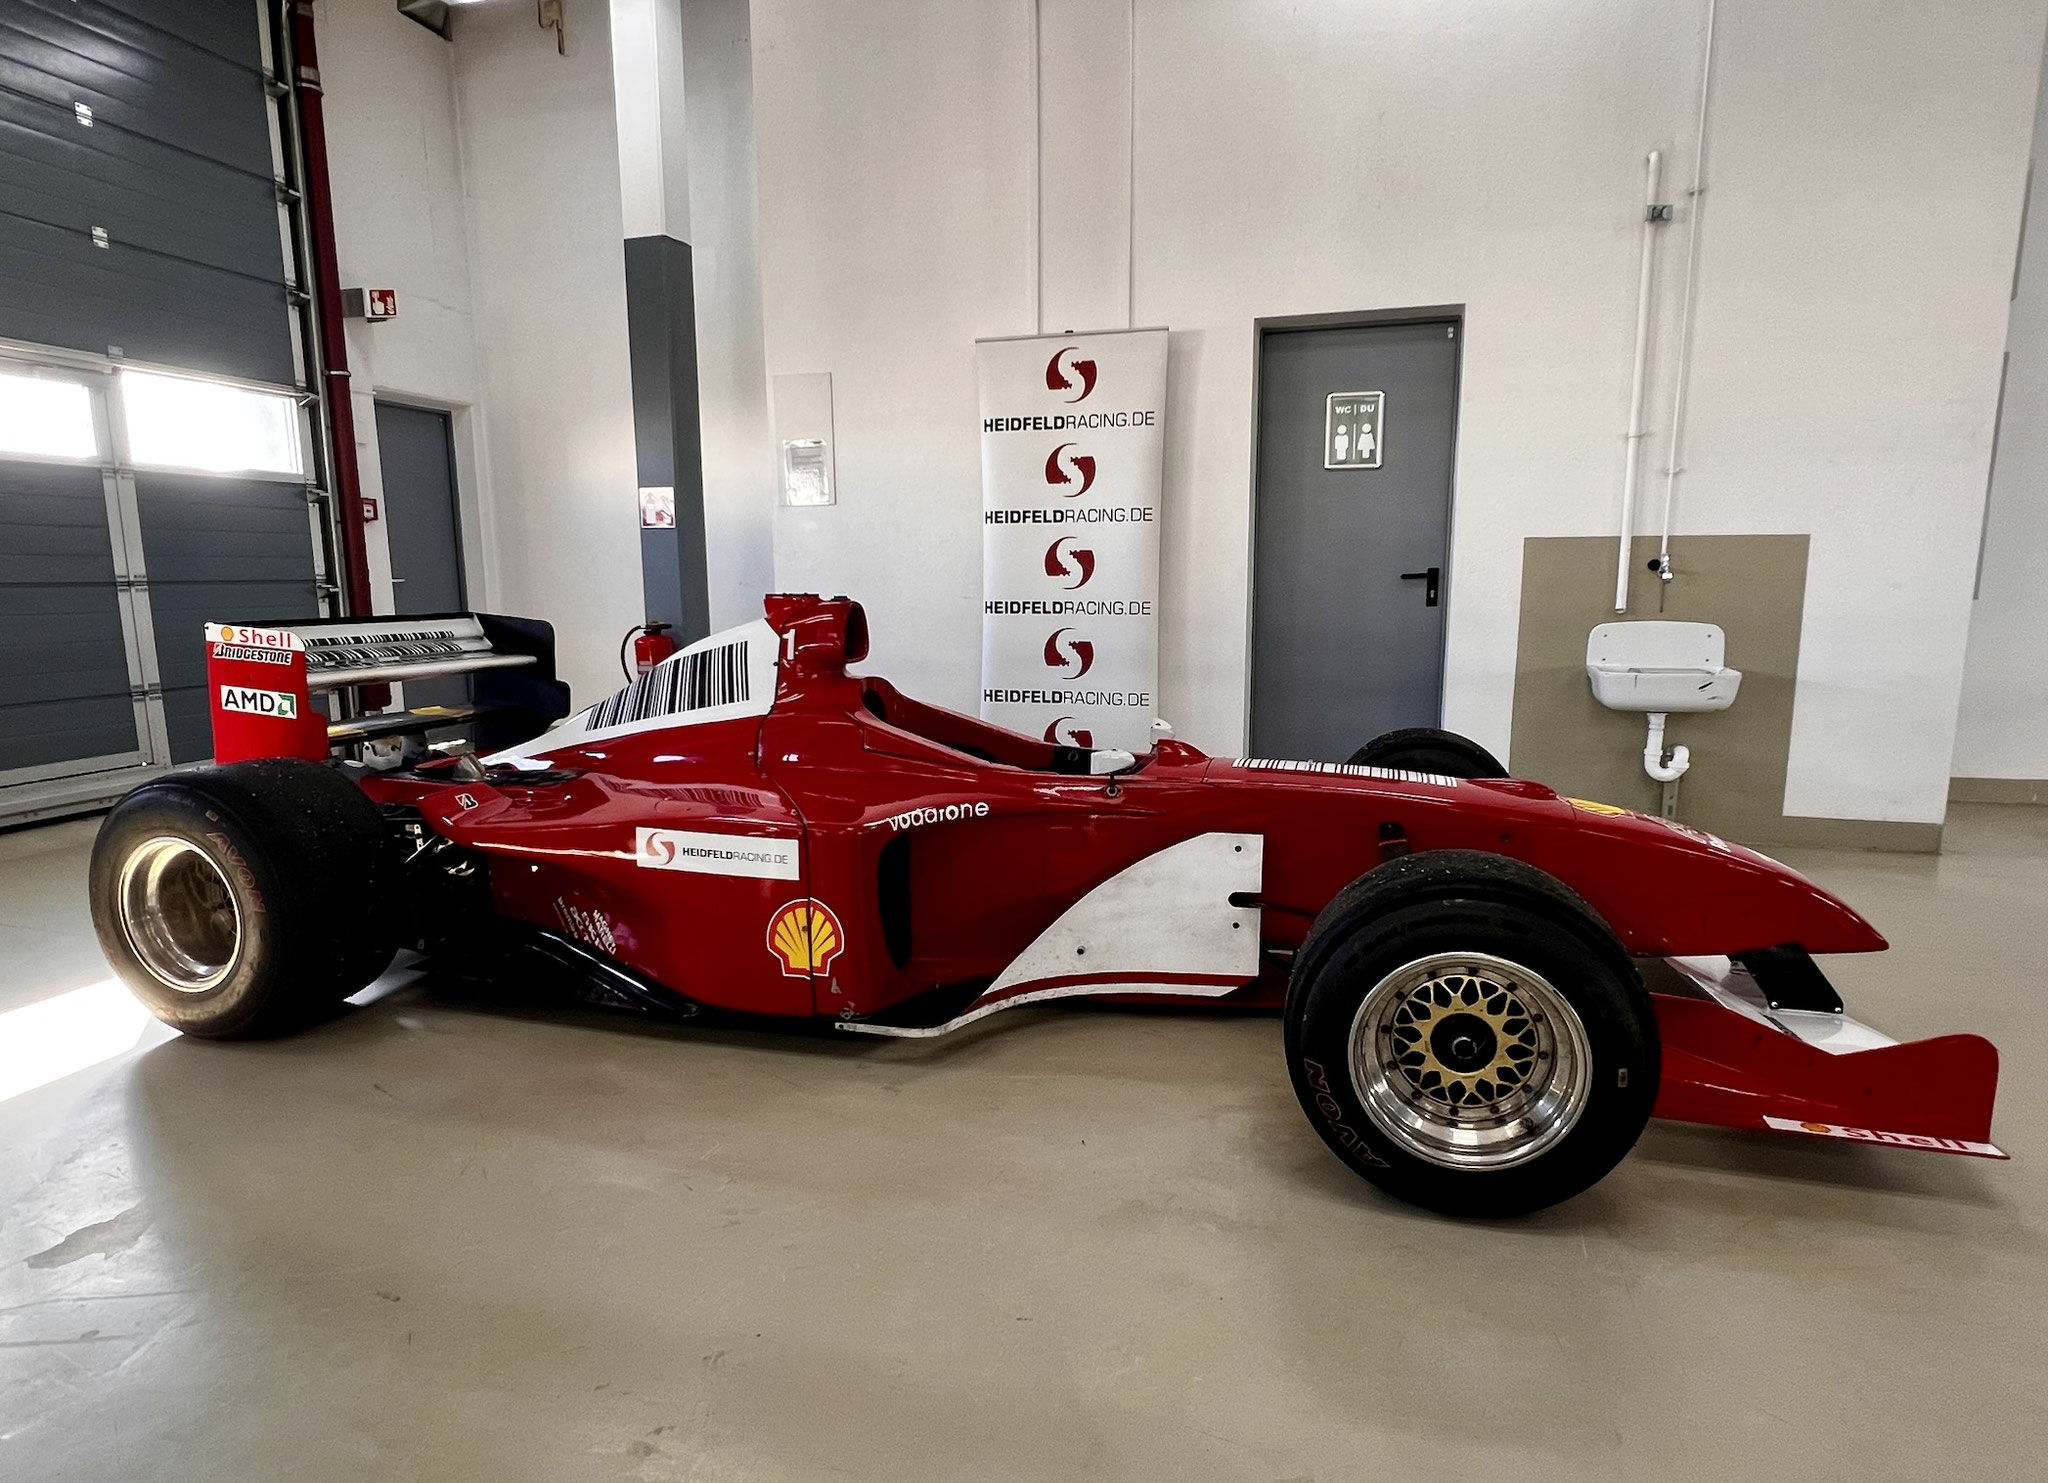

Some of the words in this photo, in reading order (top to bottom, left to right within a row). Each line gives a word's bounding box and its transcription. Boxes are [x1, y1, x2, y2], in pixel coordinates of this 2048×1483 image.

[1335, 405, 1352, 414] WC
[983, 411, 1155, 433] HEIDFELDRACING.DE
[984, 507, 1153, 525] HEIDFELDRACING.DE
[984, 600, 1151, 616] HEIDFELDRACING.DE
[239, 628, 291, 648] Shell
[782, 628, 796, 660] 1
[214, 643, 292, 664] BRIDGESTONE
[224, 688, 275, 713] AMD
[983, 689, 1150, 707] HEIDFELDRACING.DE
[682, 847, 789, 865] HEIDFELDRACING.DE
[1303, 1057, 1392, 1168] AVON
[1841, 1126, 1970, 1151] Shell
